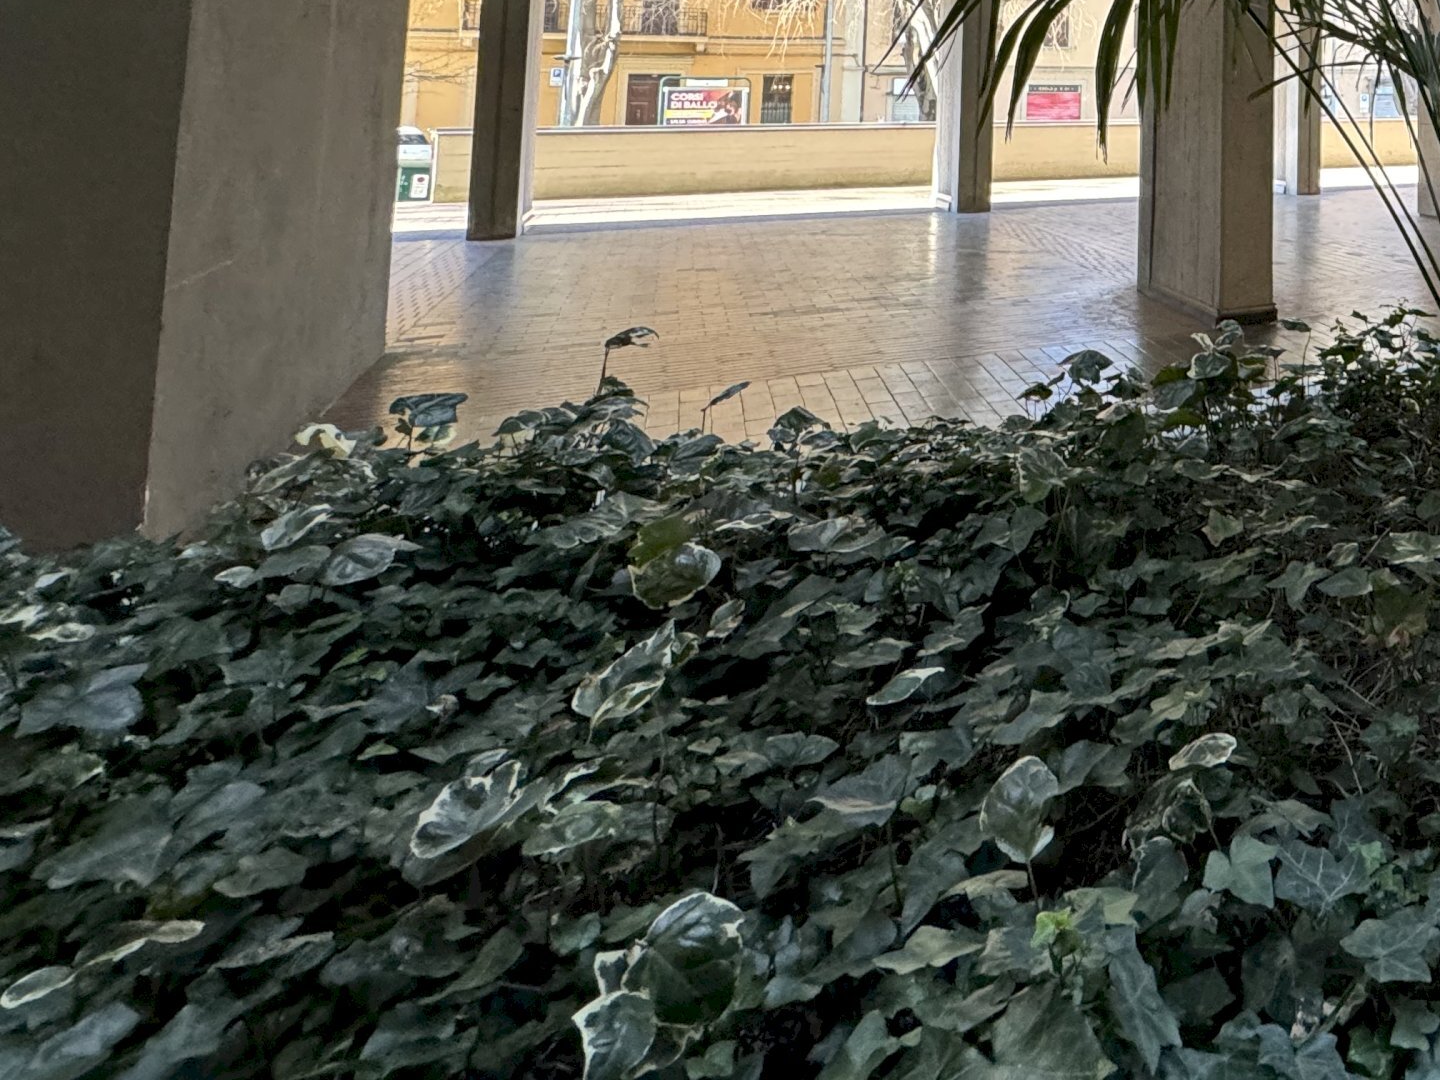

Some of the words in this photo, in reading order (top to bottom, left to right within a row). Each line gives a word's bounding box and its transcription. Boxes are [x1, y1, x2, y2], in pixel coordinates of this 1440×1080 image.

[670, 92, 704, 101] CORSI
[670, 101, 682, 109] DI
[683, 100, 718, 109] BALLO
